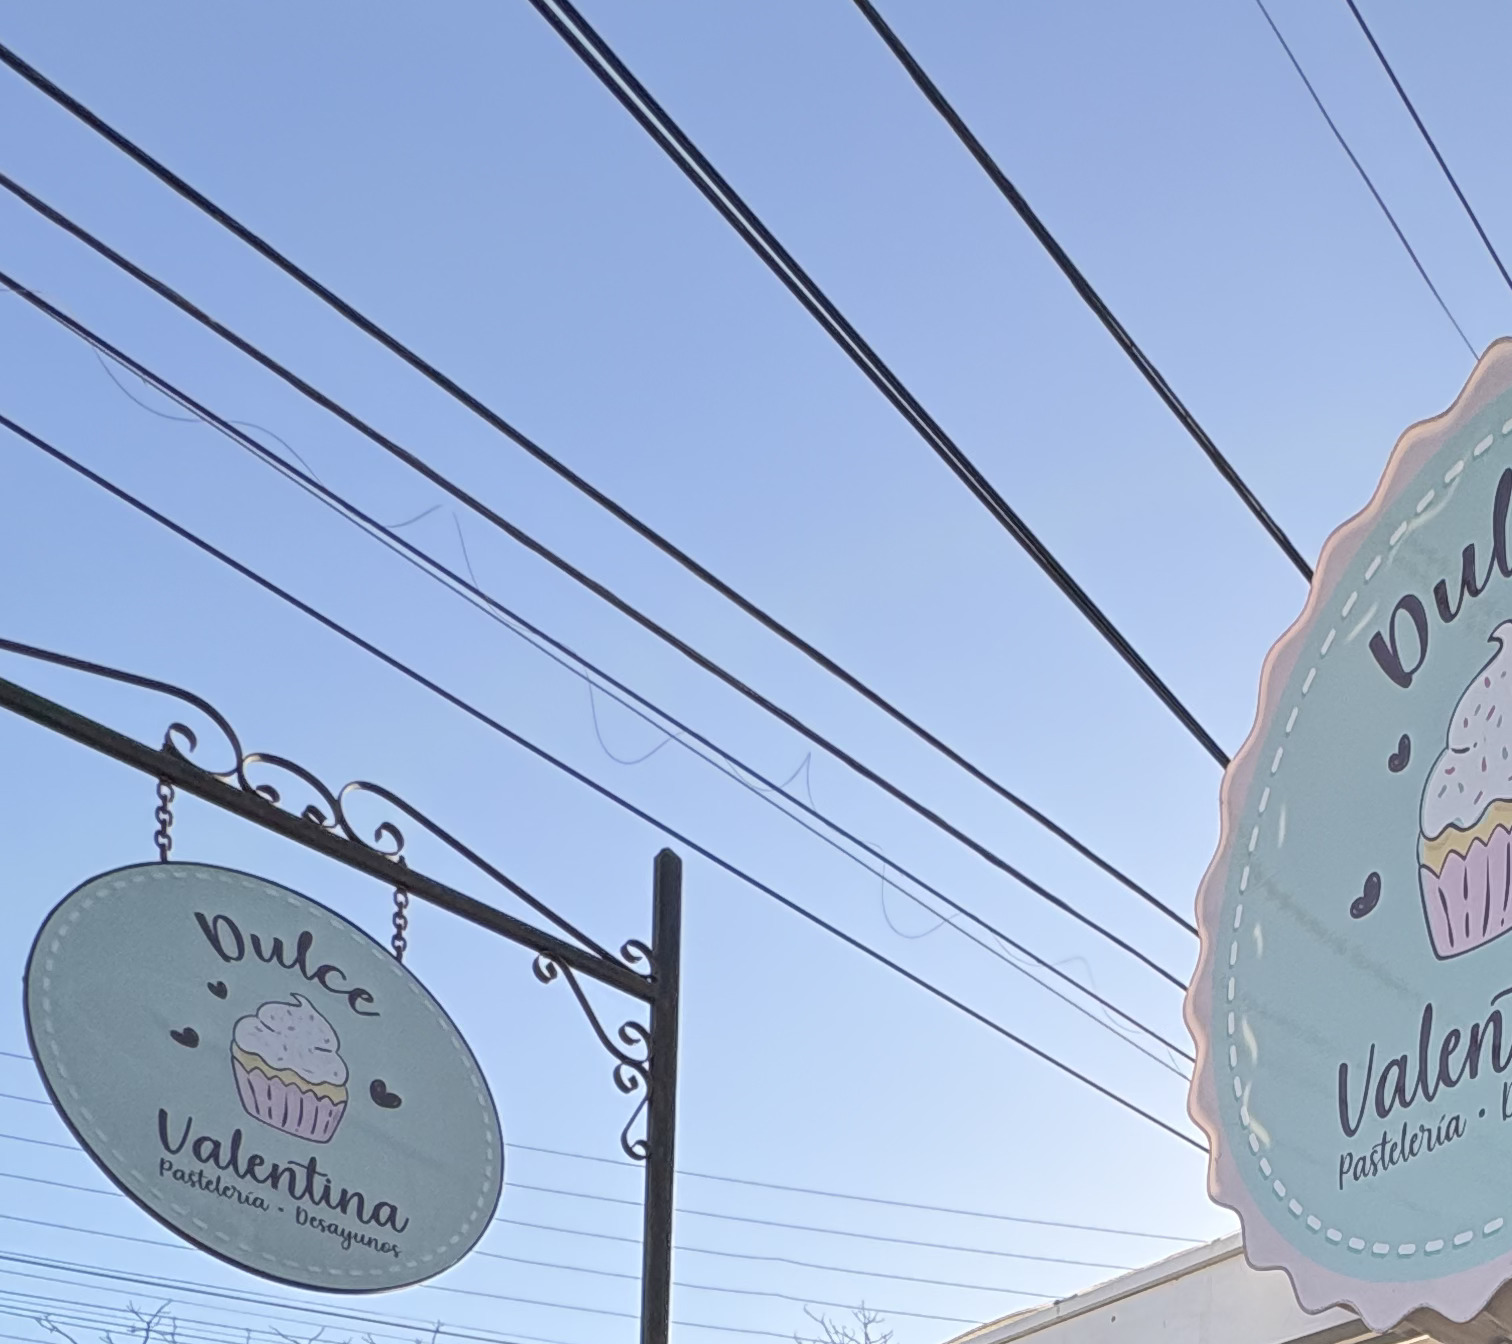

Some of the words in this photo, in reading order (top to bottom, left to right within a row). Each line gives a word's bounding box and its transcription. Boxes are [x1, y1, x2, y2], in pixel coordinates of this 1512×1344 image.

[194, 911, 381, 1017] Dulce
[157, 1107, 410, 1233] Valentina
[1338, 1112, 1467, 1191] Pastelería
[296, 1205, 402, 1258] Desayunos
